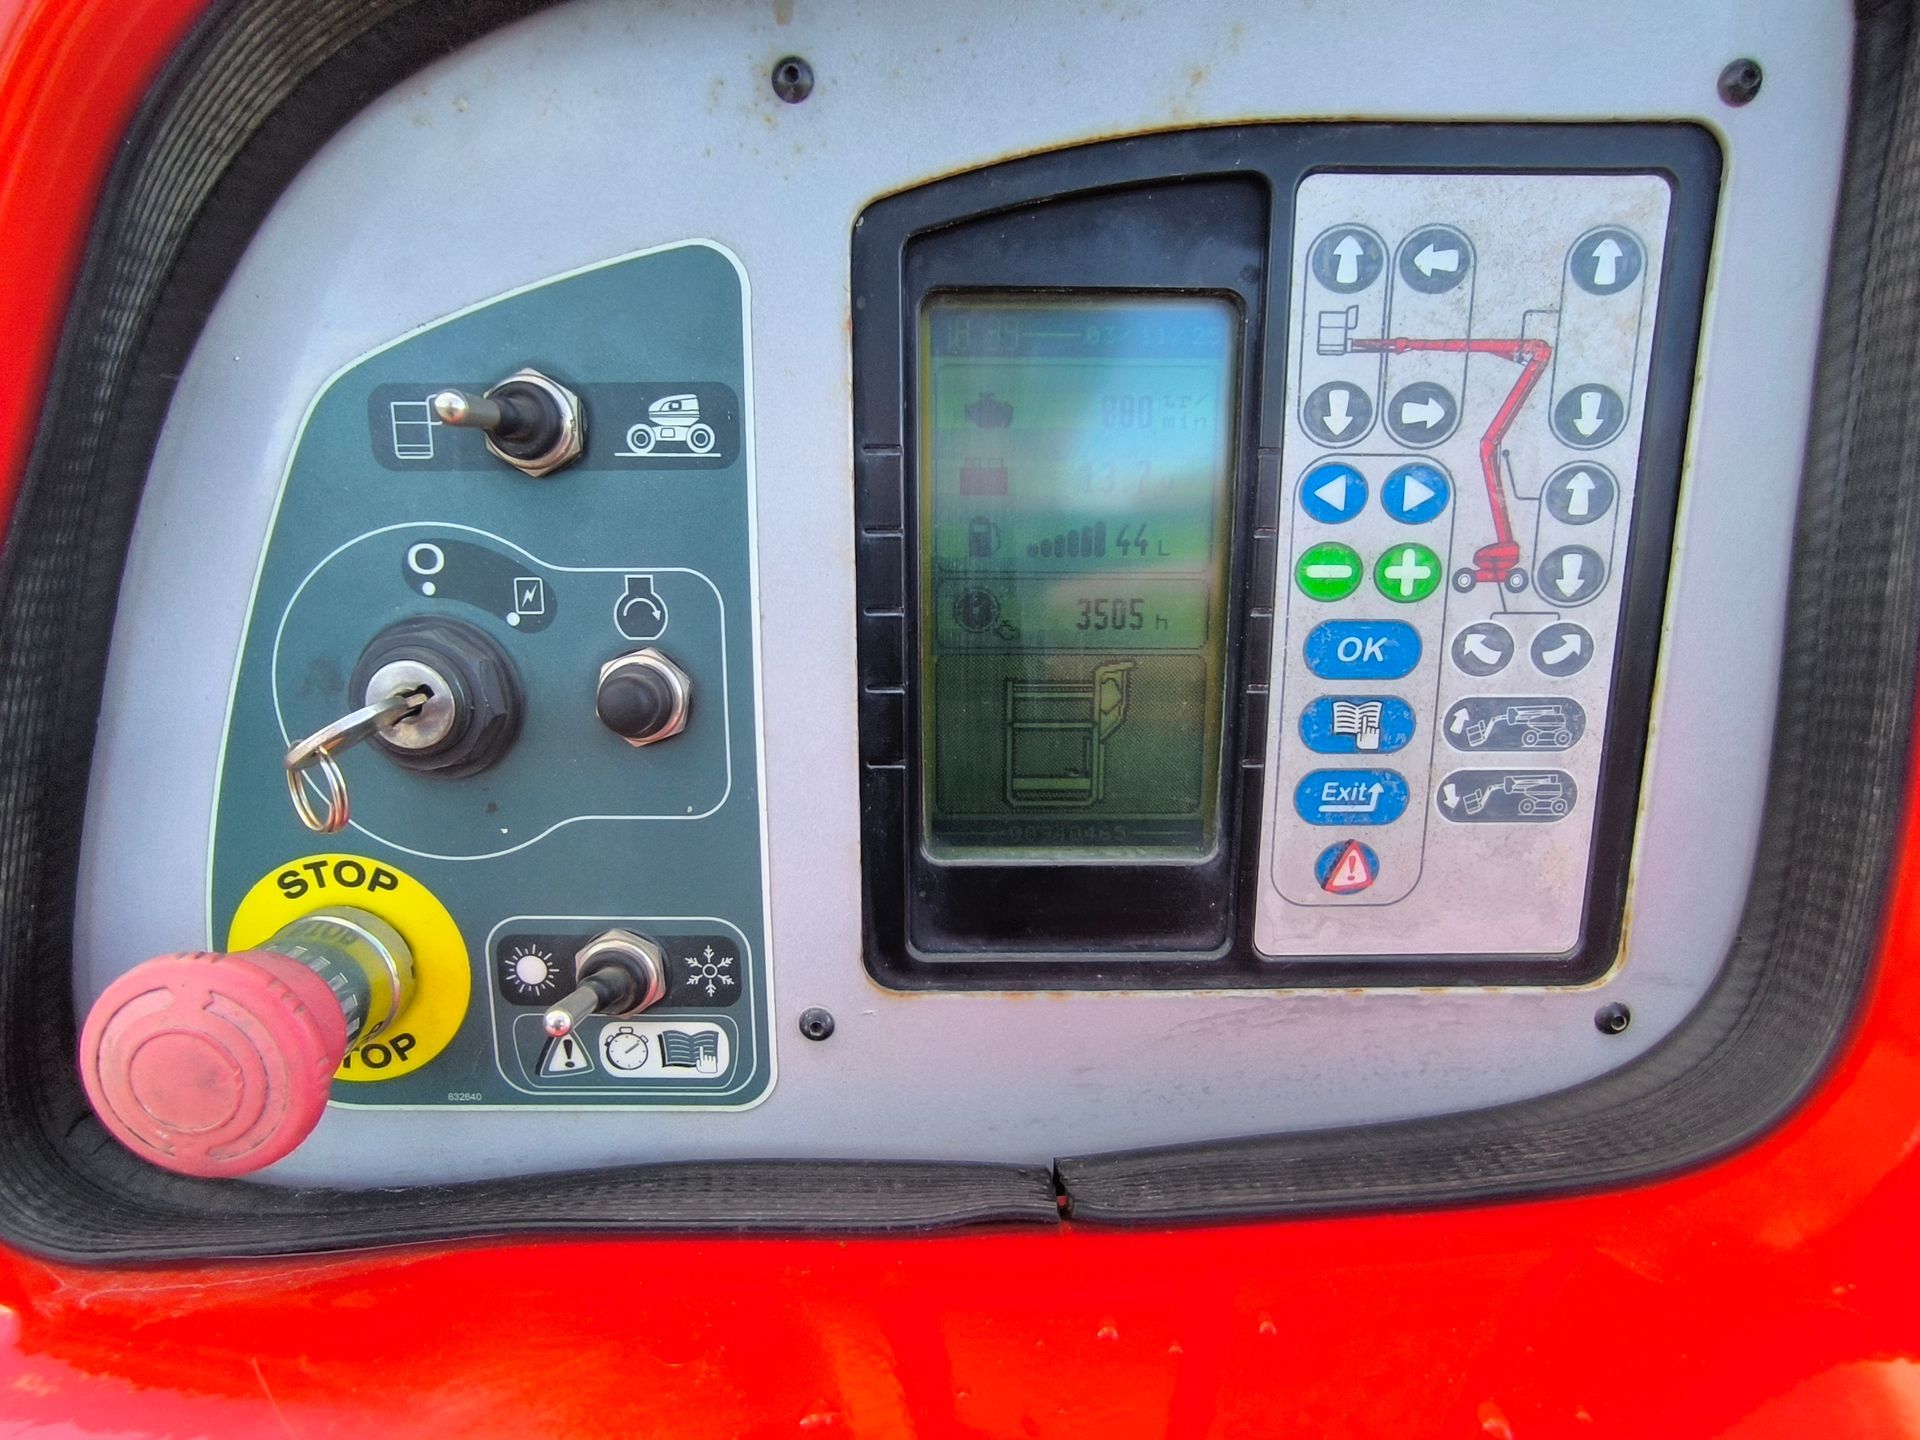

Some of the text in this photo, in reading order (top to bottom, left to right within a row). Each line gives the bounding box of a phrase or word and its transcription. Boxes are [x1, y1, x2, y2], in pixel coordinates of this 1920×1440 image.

[1115, 521, 1171, 557] 44 L
[1076, 597, 1144, 631] 3505
[1336, 636, 1388, 662] OK
[1321, 781, 1367, 802] Exit
[277, 860, 399, 899] STOP
[342, 1032, 416, 1069] TOP
